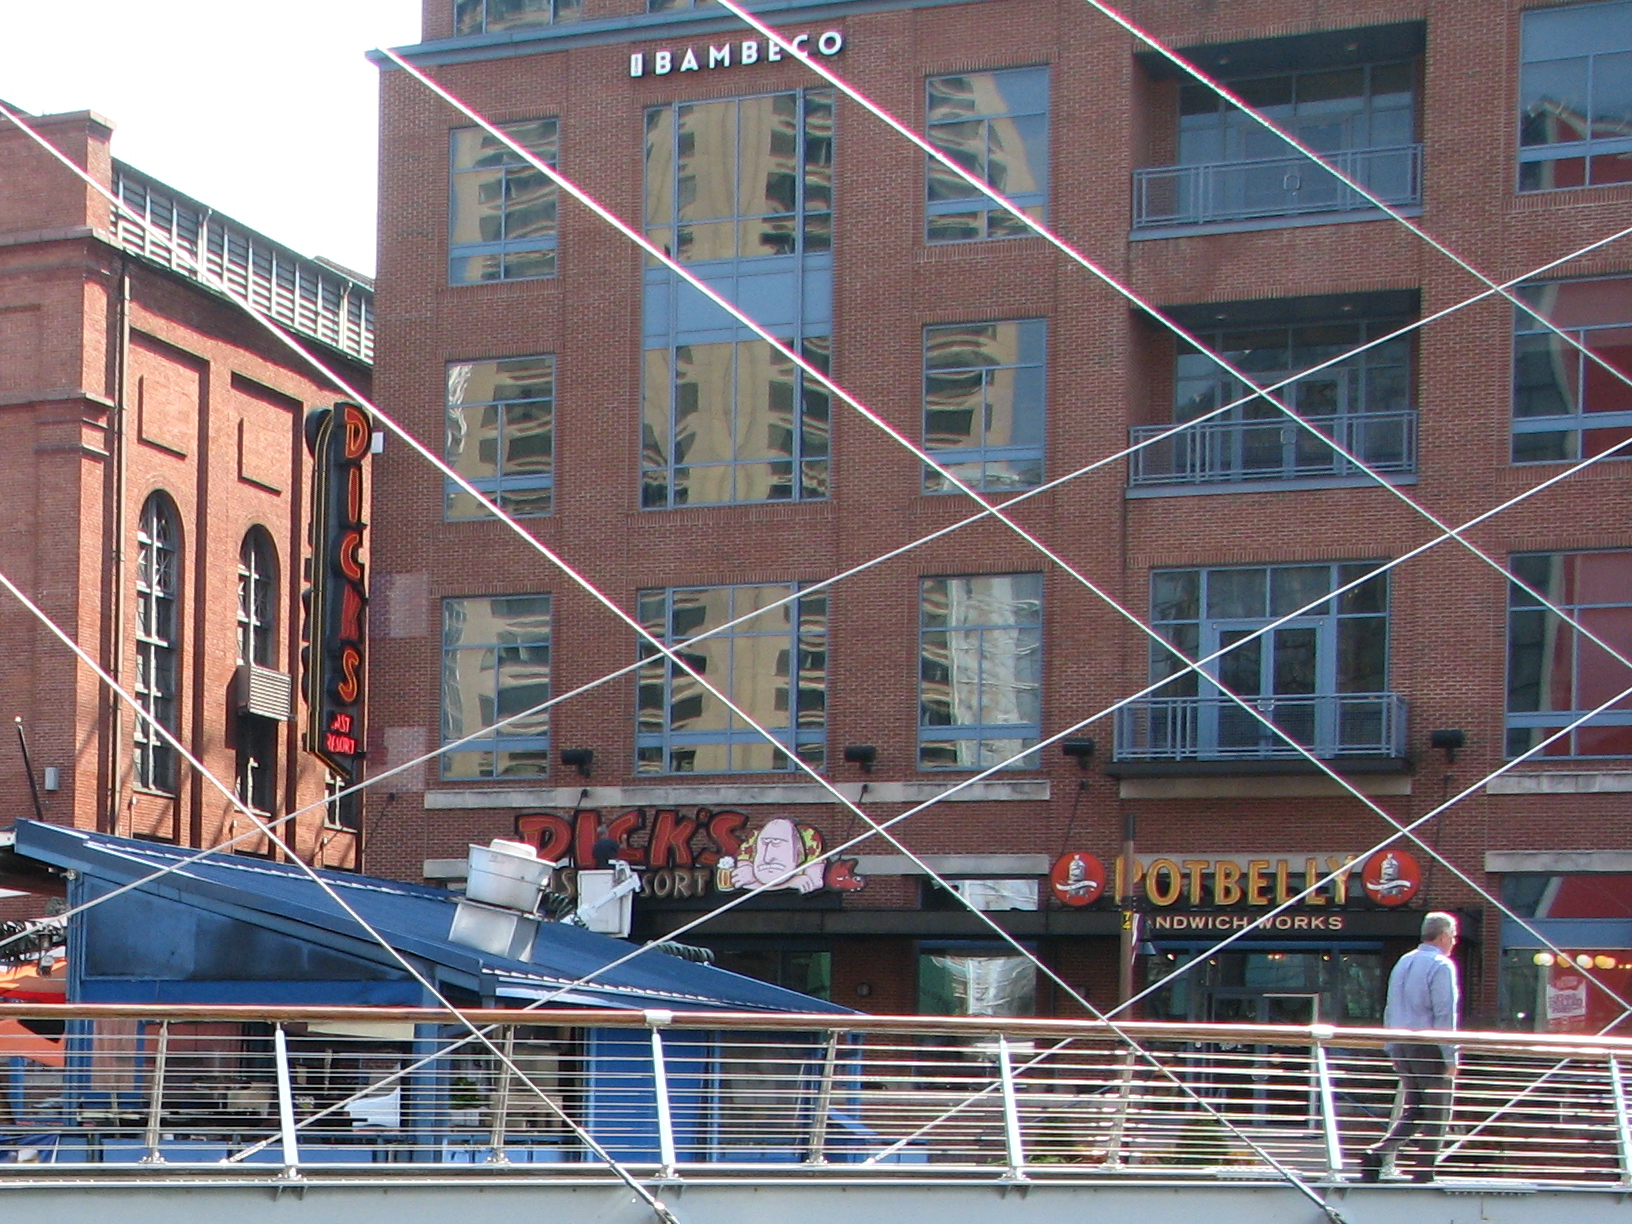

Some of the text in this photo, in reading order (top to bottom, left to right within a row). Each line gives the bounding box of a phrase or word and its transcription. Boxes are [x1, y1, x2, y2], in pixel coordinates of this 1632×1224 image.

[655, 31, 843, 76] BAMBECO
[518, 808, 749, 867] DICK'S
[1256, 915, 1344, 931] WORKS
